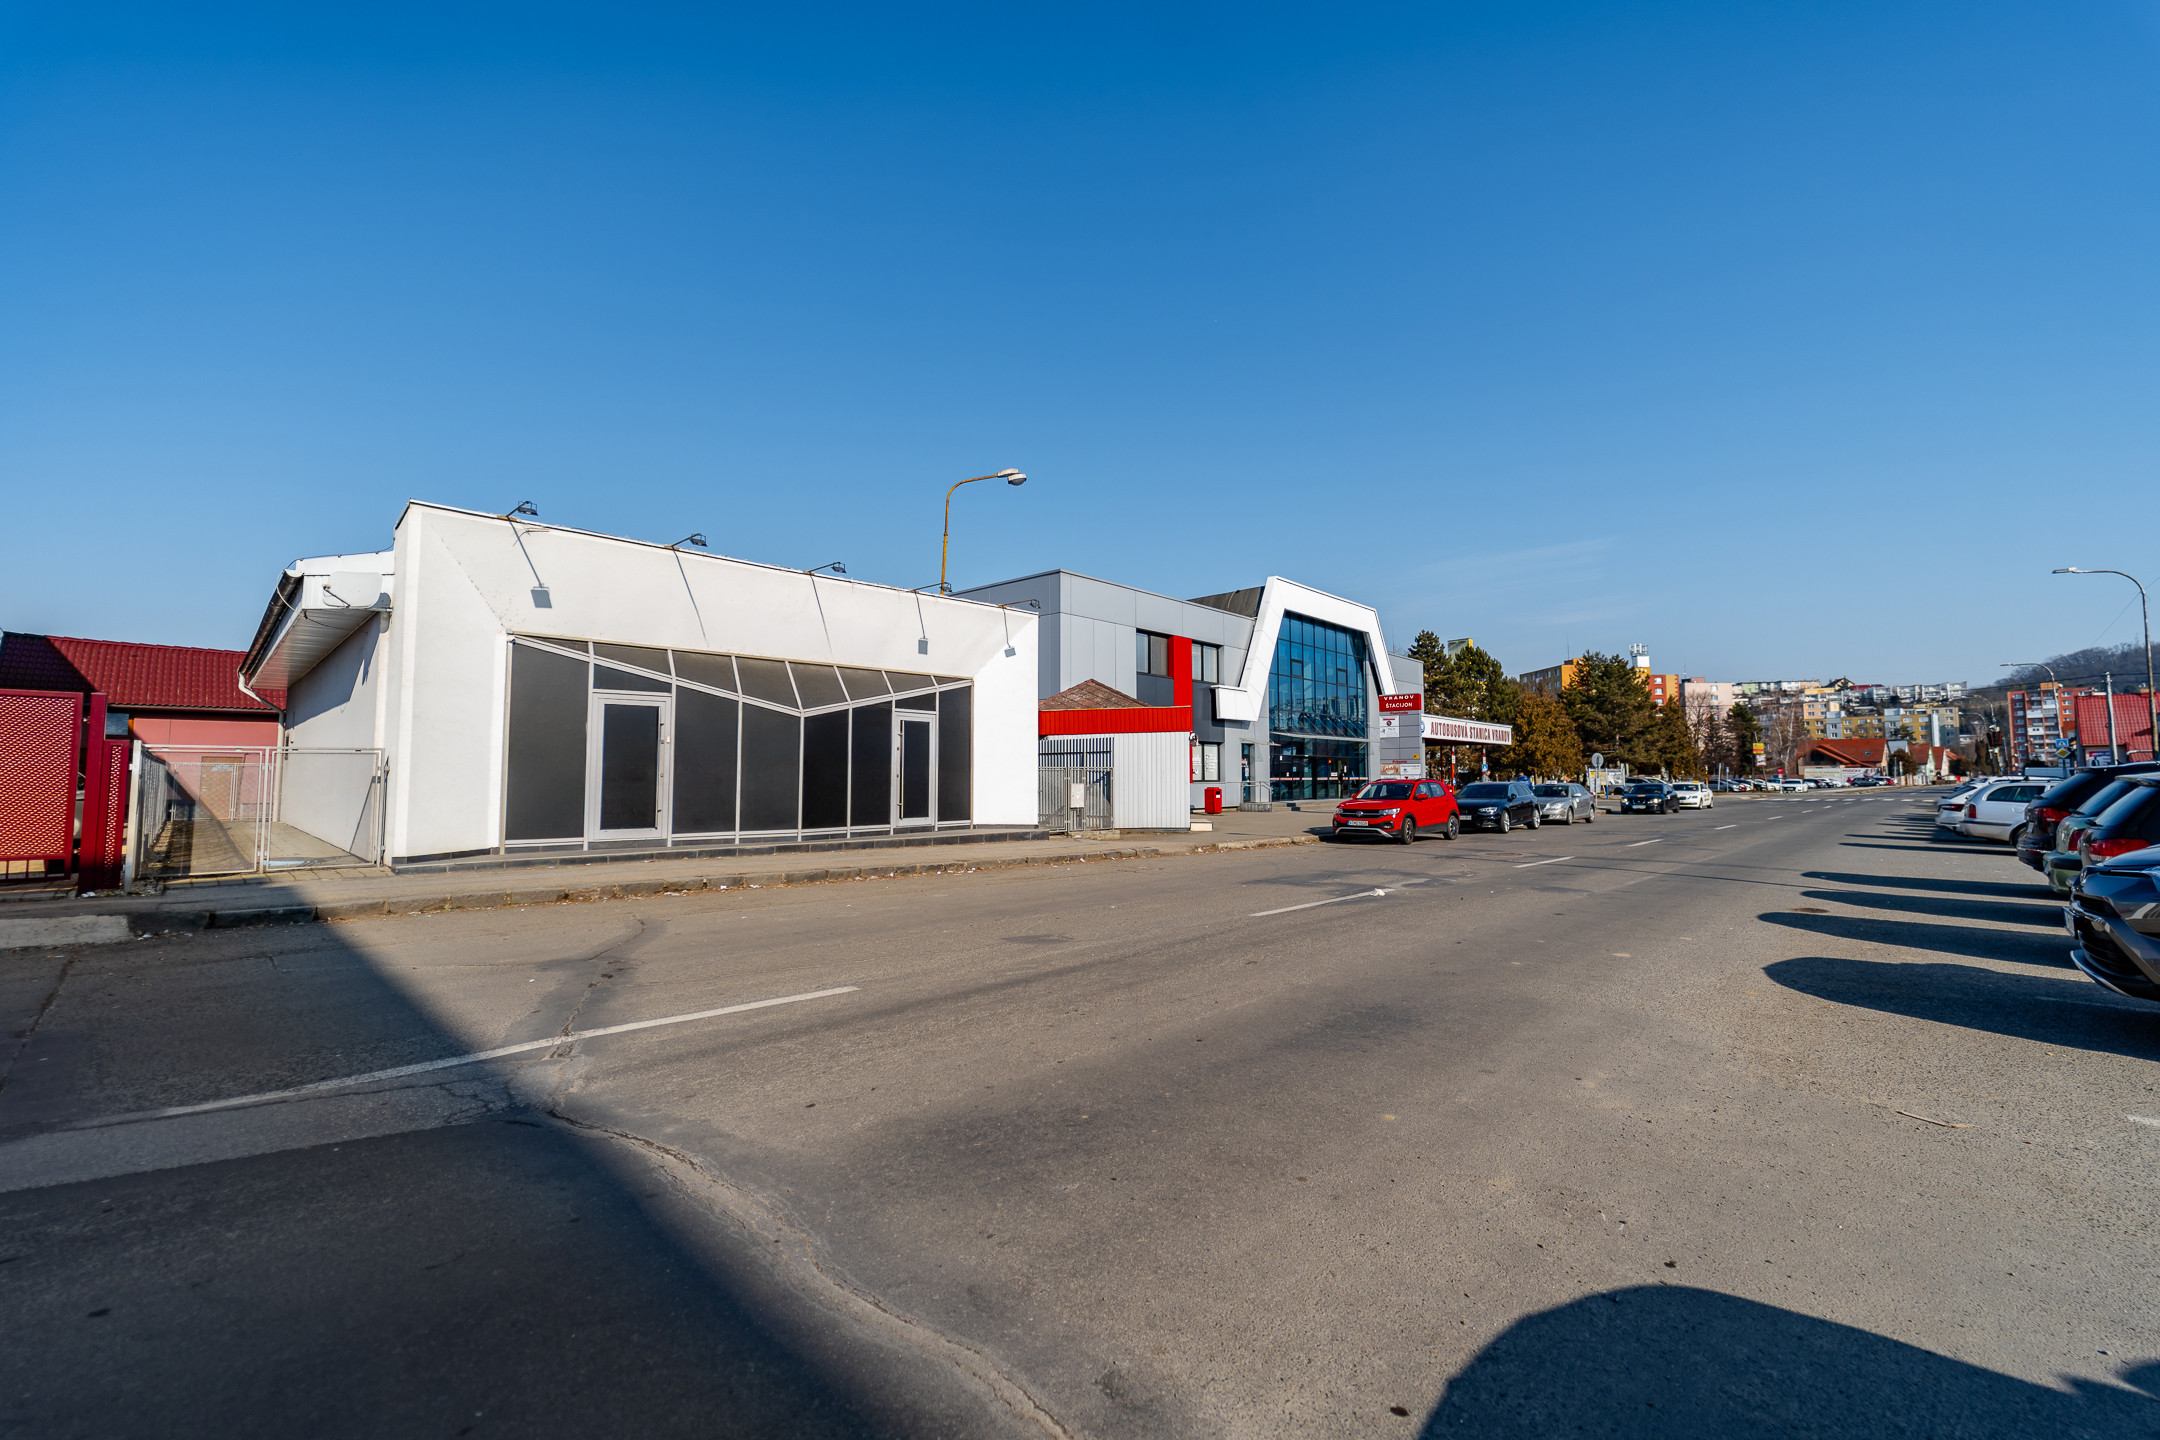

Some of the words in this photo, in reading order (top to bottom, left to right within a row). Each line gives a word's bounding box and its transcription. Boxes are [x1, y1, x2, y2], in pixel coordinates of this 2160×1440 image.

[1431, 722, 1468, 738] AUTOBUSOVÁ
[1469, 726, 1490, 740] STANICA
[1491, 728, 1511, 742] VRANOV
